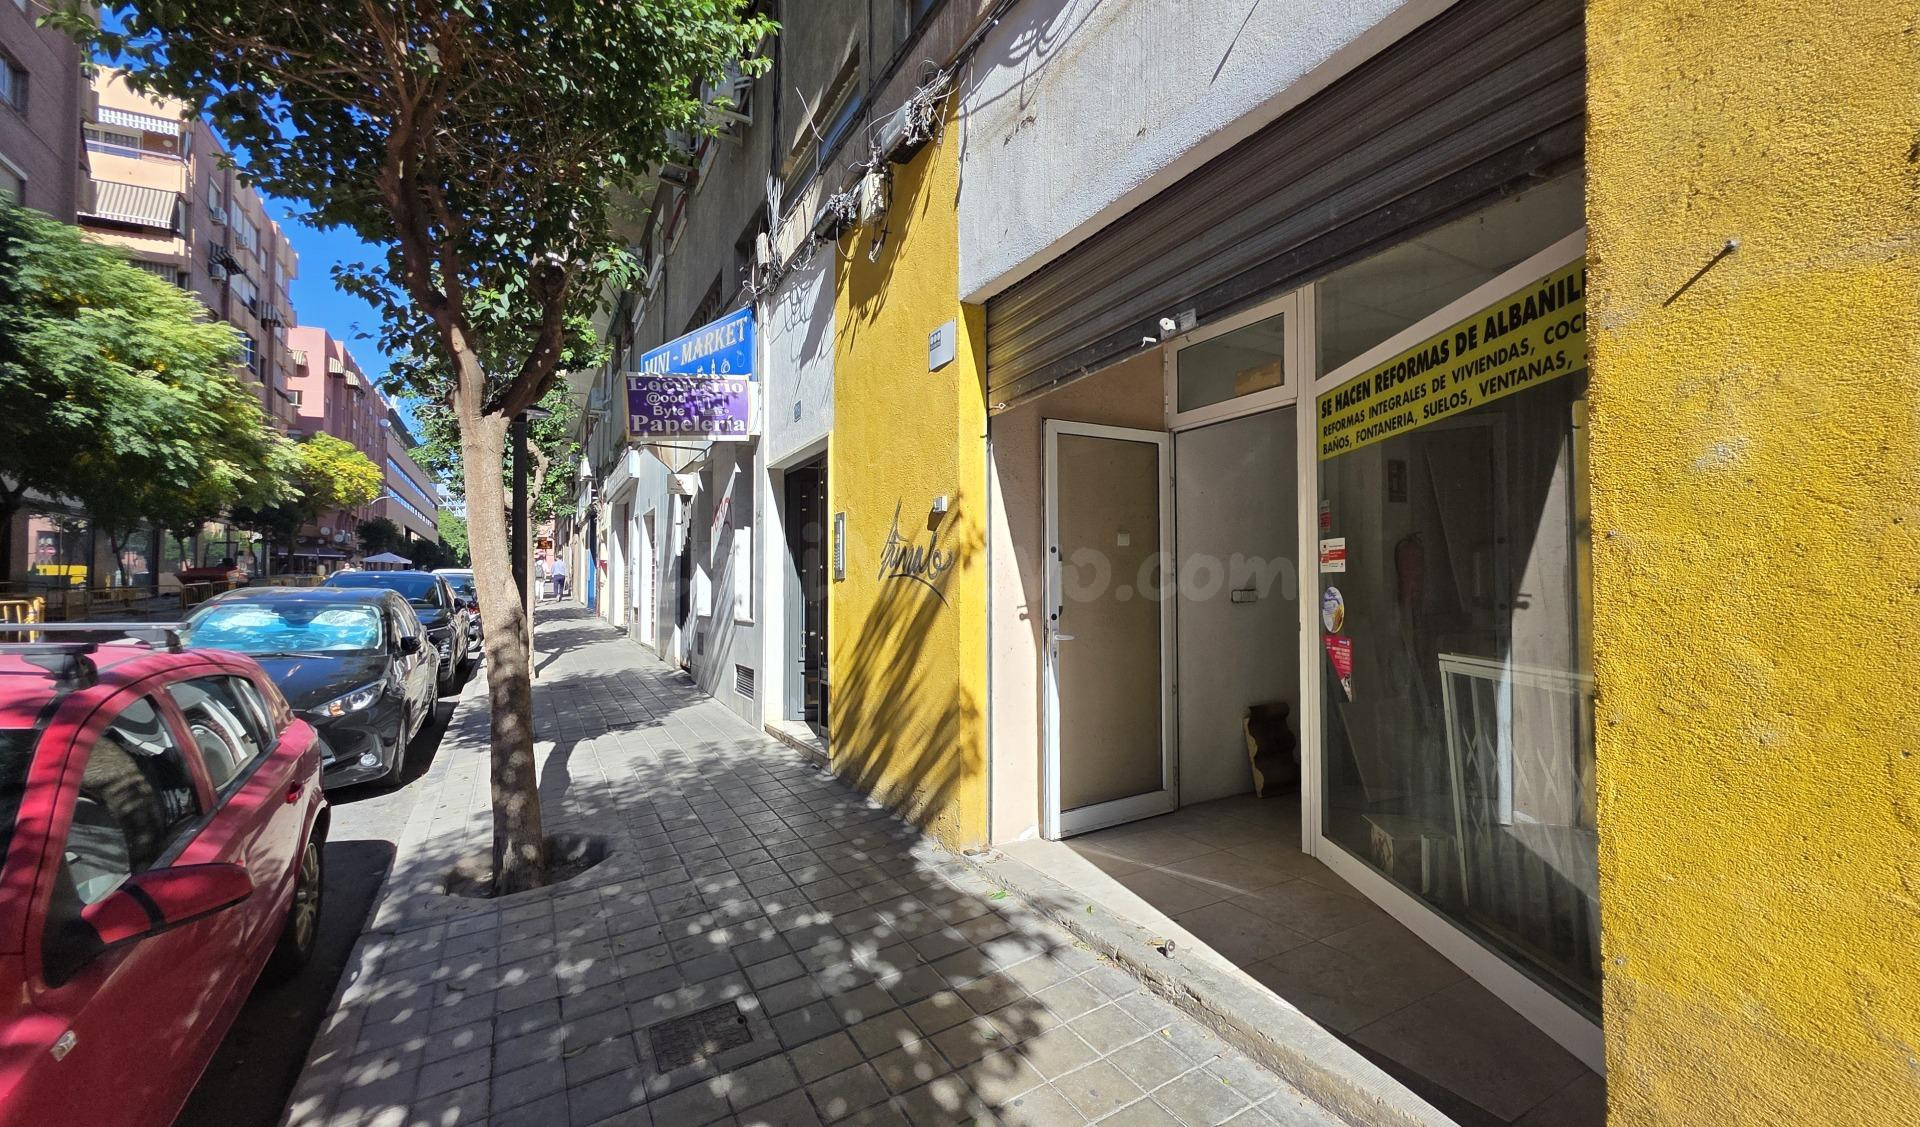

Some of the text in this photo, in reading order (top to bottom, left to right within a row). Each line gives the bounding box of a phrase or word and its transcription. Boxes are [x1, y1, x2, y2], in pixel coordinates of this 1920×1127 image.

[644, 351, 670, 373] MINI
[680, 316, 747, 366] MARKET
[1321, 398, 1332, 419] SE
[1335, 379, 1371, 412] HACEN
[1374, 339, 1449, 394] REFORMAS
[1455, 324, 1477, 358] DE
[628, 377, 744, 393] Locutorio
[653, 405, 685, 418] Byte
[1323, 410, 1365, 438] REFORMAS
[1368, 383, 1427, 419] INTEGRALES
[1431, 375, 1446, 393] DE
[1451, 338, 1535, 384] VIVIENDAS,
[1323, 350, 1573, 455] BAÑOS, FONTANERIA, SUELOS, VENTANAS,
[631, 414, 746, 436] Papelería
